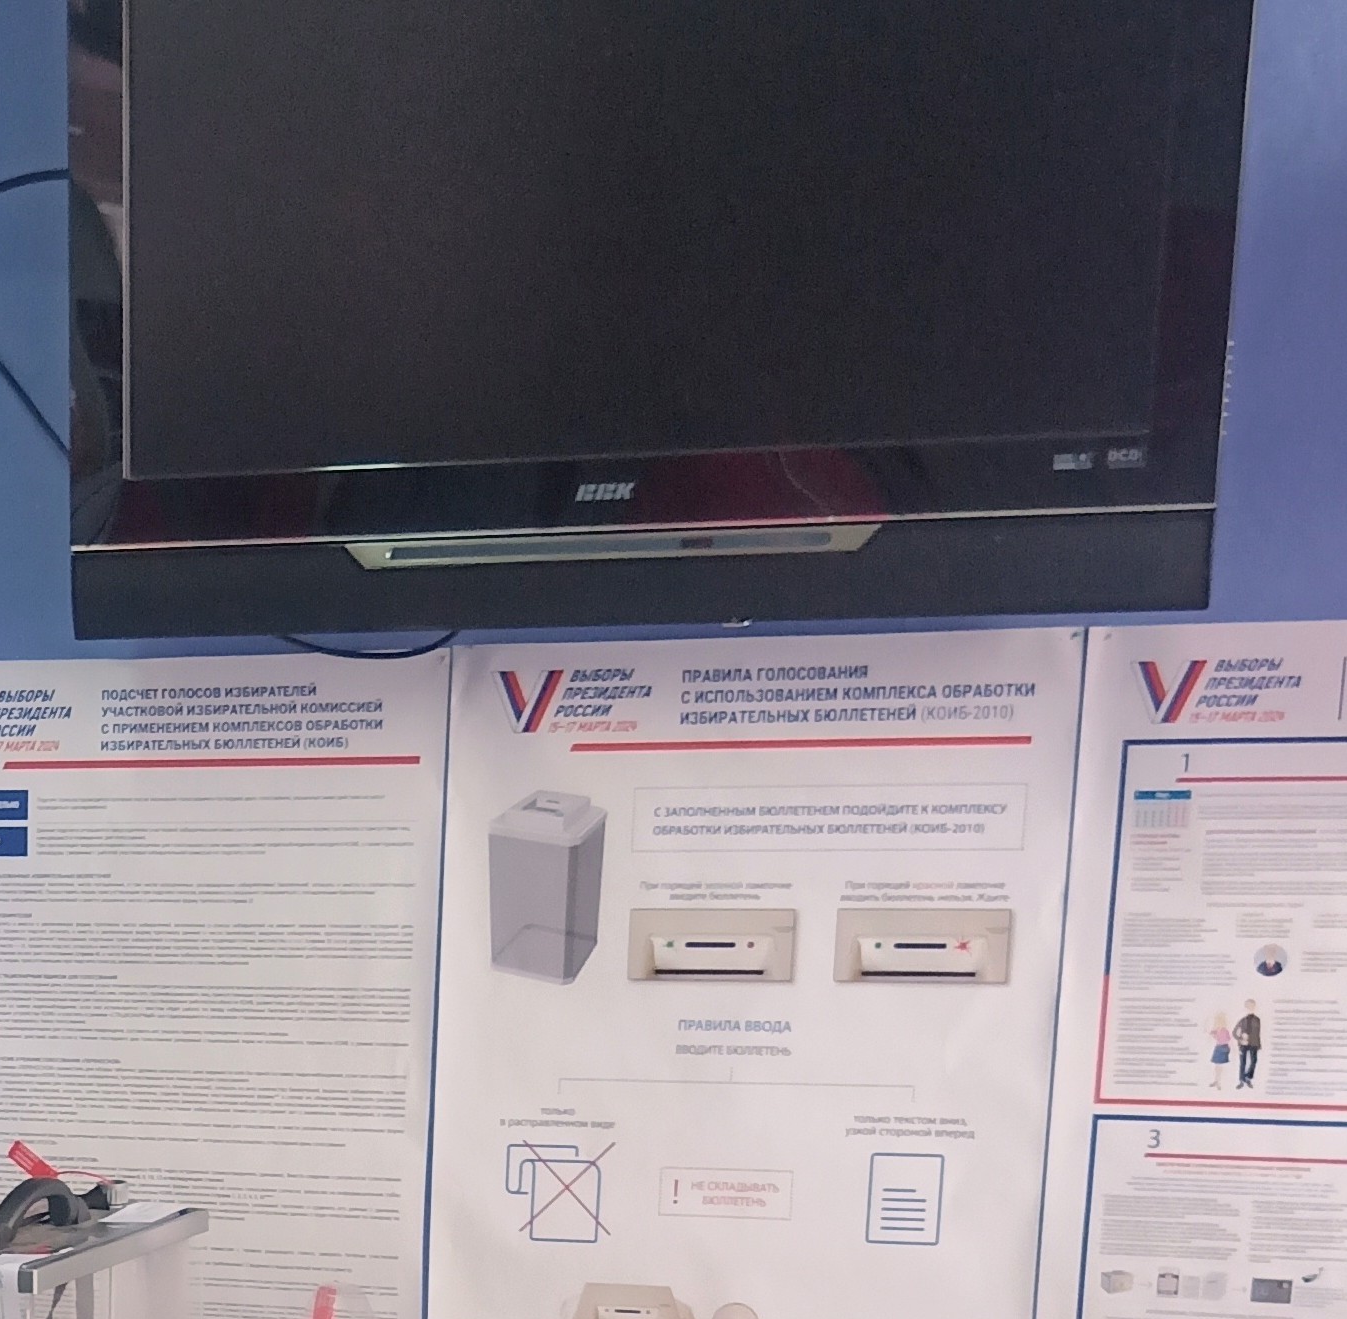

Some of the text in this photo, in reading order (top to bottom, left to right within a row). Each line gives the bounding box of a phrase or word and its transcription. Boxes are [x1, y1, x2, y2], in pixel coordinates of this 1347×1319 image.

[1214, 657, 1284, 672] ВЫБОРЫ
[569, 668, 635, 683] ВЫБОРЫ
[682, 665, 868, 683] ПРАВИЛА ГОЛОСОВАНИЯ
[1204, 675, 1302, 690] ПРЕЗИДЕНТА
[101, 683, 317, 702] ПОДСЧЕТ ГОЛОСОВ ИЗБИРАТЕЛЕЙ
[562, 685, 652, 700] ПРЕЗИДЕНТА
[681, 683, 1036, 704] С ИСПОЛЬЗОВАНИЕМ КОМПЛЕКСА ОБРАБОТКИ
[101, 698, 383, 718] УЧАСТКОВОЙ ИЗБИРАТЕЛЬНОЙ КОМИССИЕЙ
[1195, 694, 1259, 708] РОССИИ
[554, 704, 613, 718] РОССИИ
[679, 704, 1014, 725] ИЗБИРАТЕЛЬНЫХ БЮЛЛЕТЕНЕЙ (КОИБ-2010)
[101, 719, 383, 735] С ПРИМЕНЕНИЕМ КОМПЛЕКСОВ ОБРАБОТКИ
[101, 735, 349, 752] ИЗБИРАТЕЛЬНЫХ БЮЛЛЕТЕНЕЙ (КОИБ)
[1181, 753, 1190, 772] 1
[653, 803, 1007, 817] С ЗАПОЛНЕННЫМ БЮЛЛЕТЕНЕМ ПОДОЙДИТЕ К КОМПЛЕКСУ
[653, 822, 985, 836] ОБРАБОТКИ ИЗБИРАТЕЛЬНЫХ БЮЛЛЕТЕНЕЙ (КОИБ-2010)
[677, 1020, 792, 1033] ПРАВИЛА ВВОДА
[1147, 1128, 1161, 1149] 3
